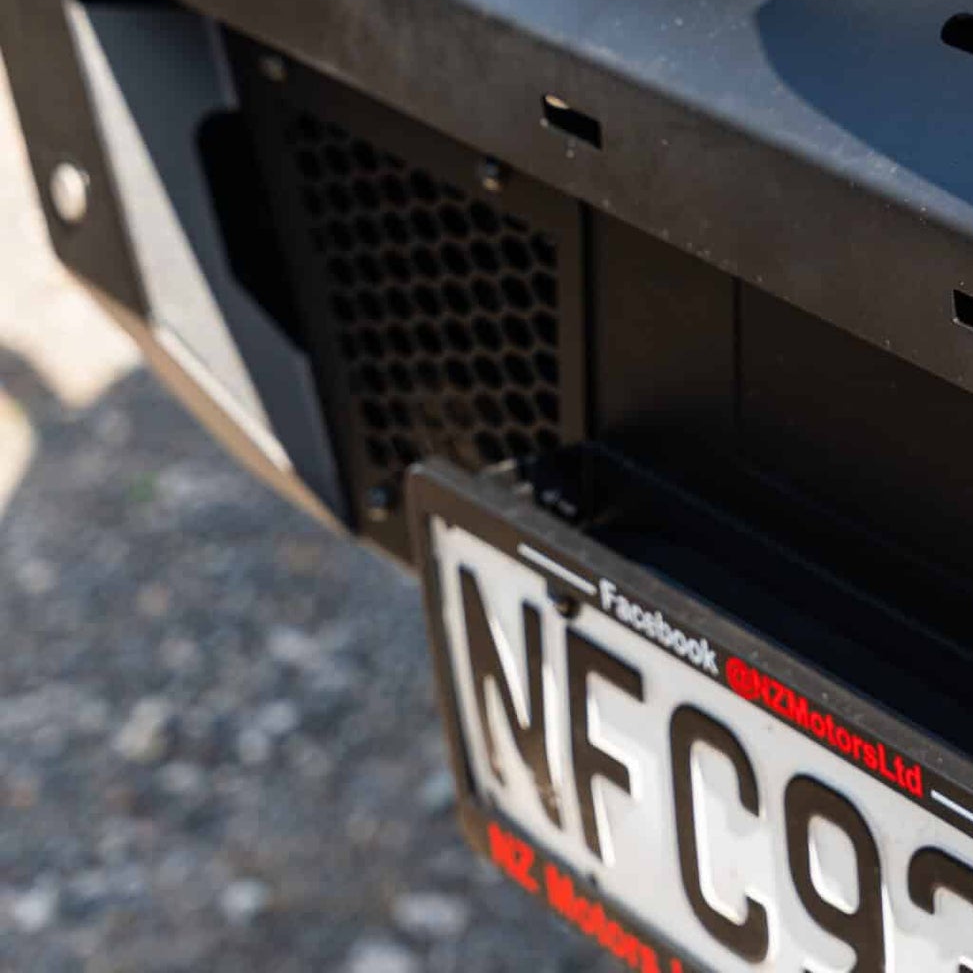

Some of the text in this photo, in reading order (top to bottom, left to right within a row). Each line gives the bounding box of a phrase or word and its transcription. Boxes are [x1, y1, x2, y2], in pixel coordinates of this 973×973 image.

[600, 577, 924, 798] Facebook @NZMotorsLtd
[488, 823, 539, 893] NZ
